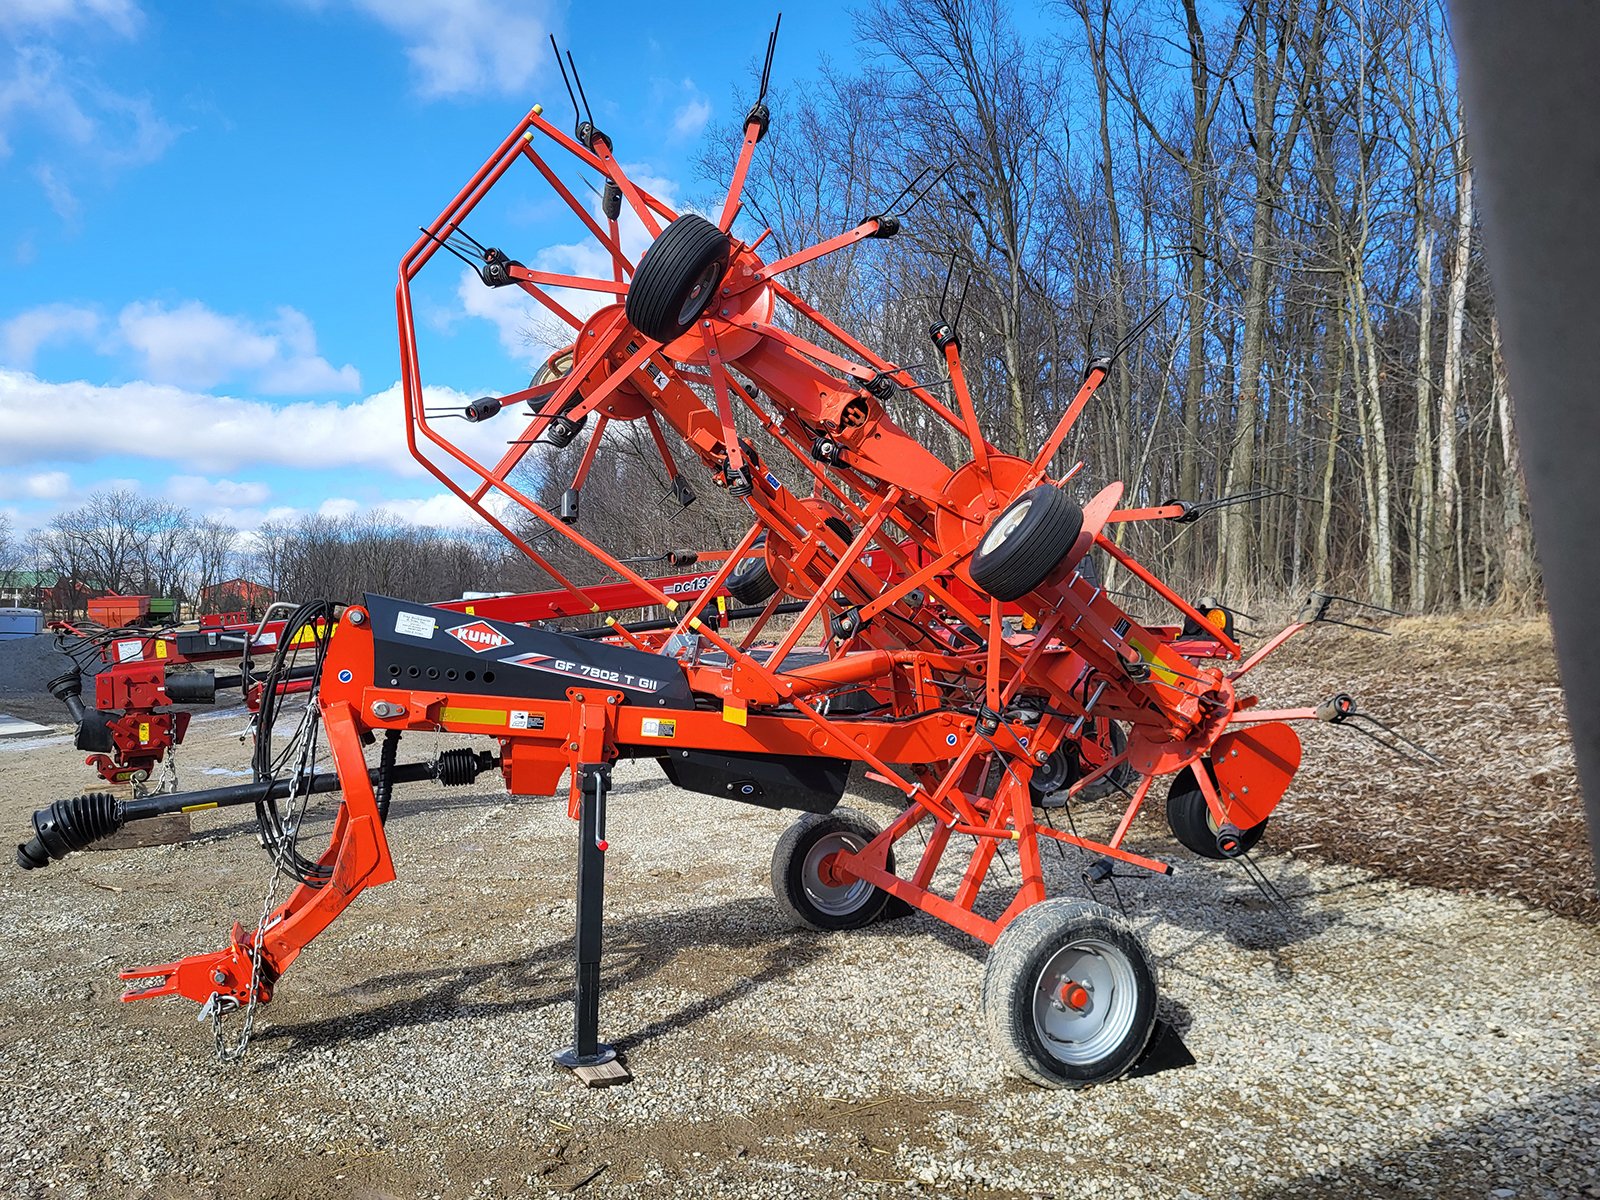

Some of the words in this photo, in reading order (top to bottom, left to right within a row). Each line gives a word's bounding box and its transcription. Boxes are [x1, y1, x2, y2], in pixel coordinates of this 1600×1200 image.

[457, 628, 503, 646] KUHN
[554, 659, 576, 672] GF
[580, 665, 620, 682] 7802
[624, 674, 635, 685] T
